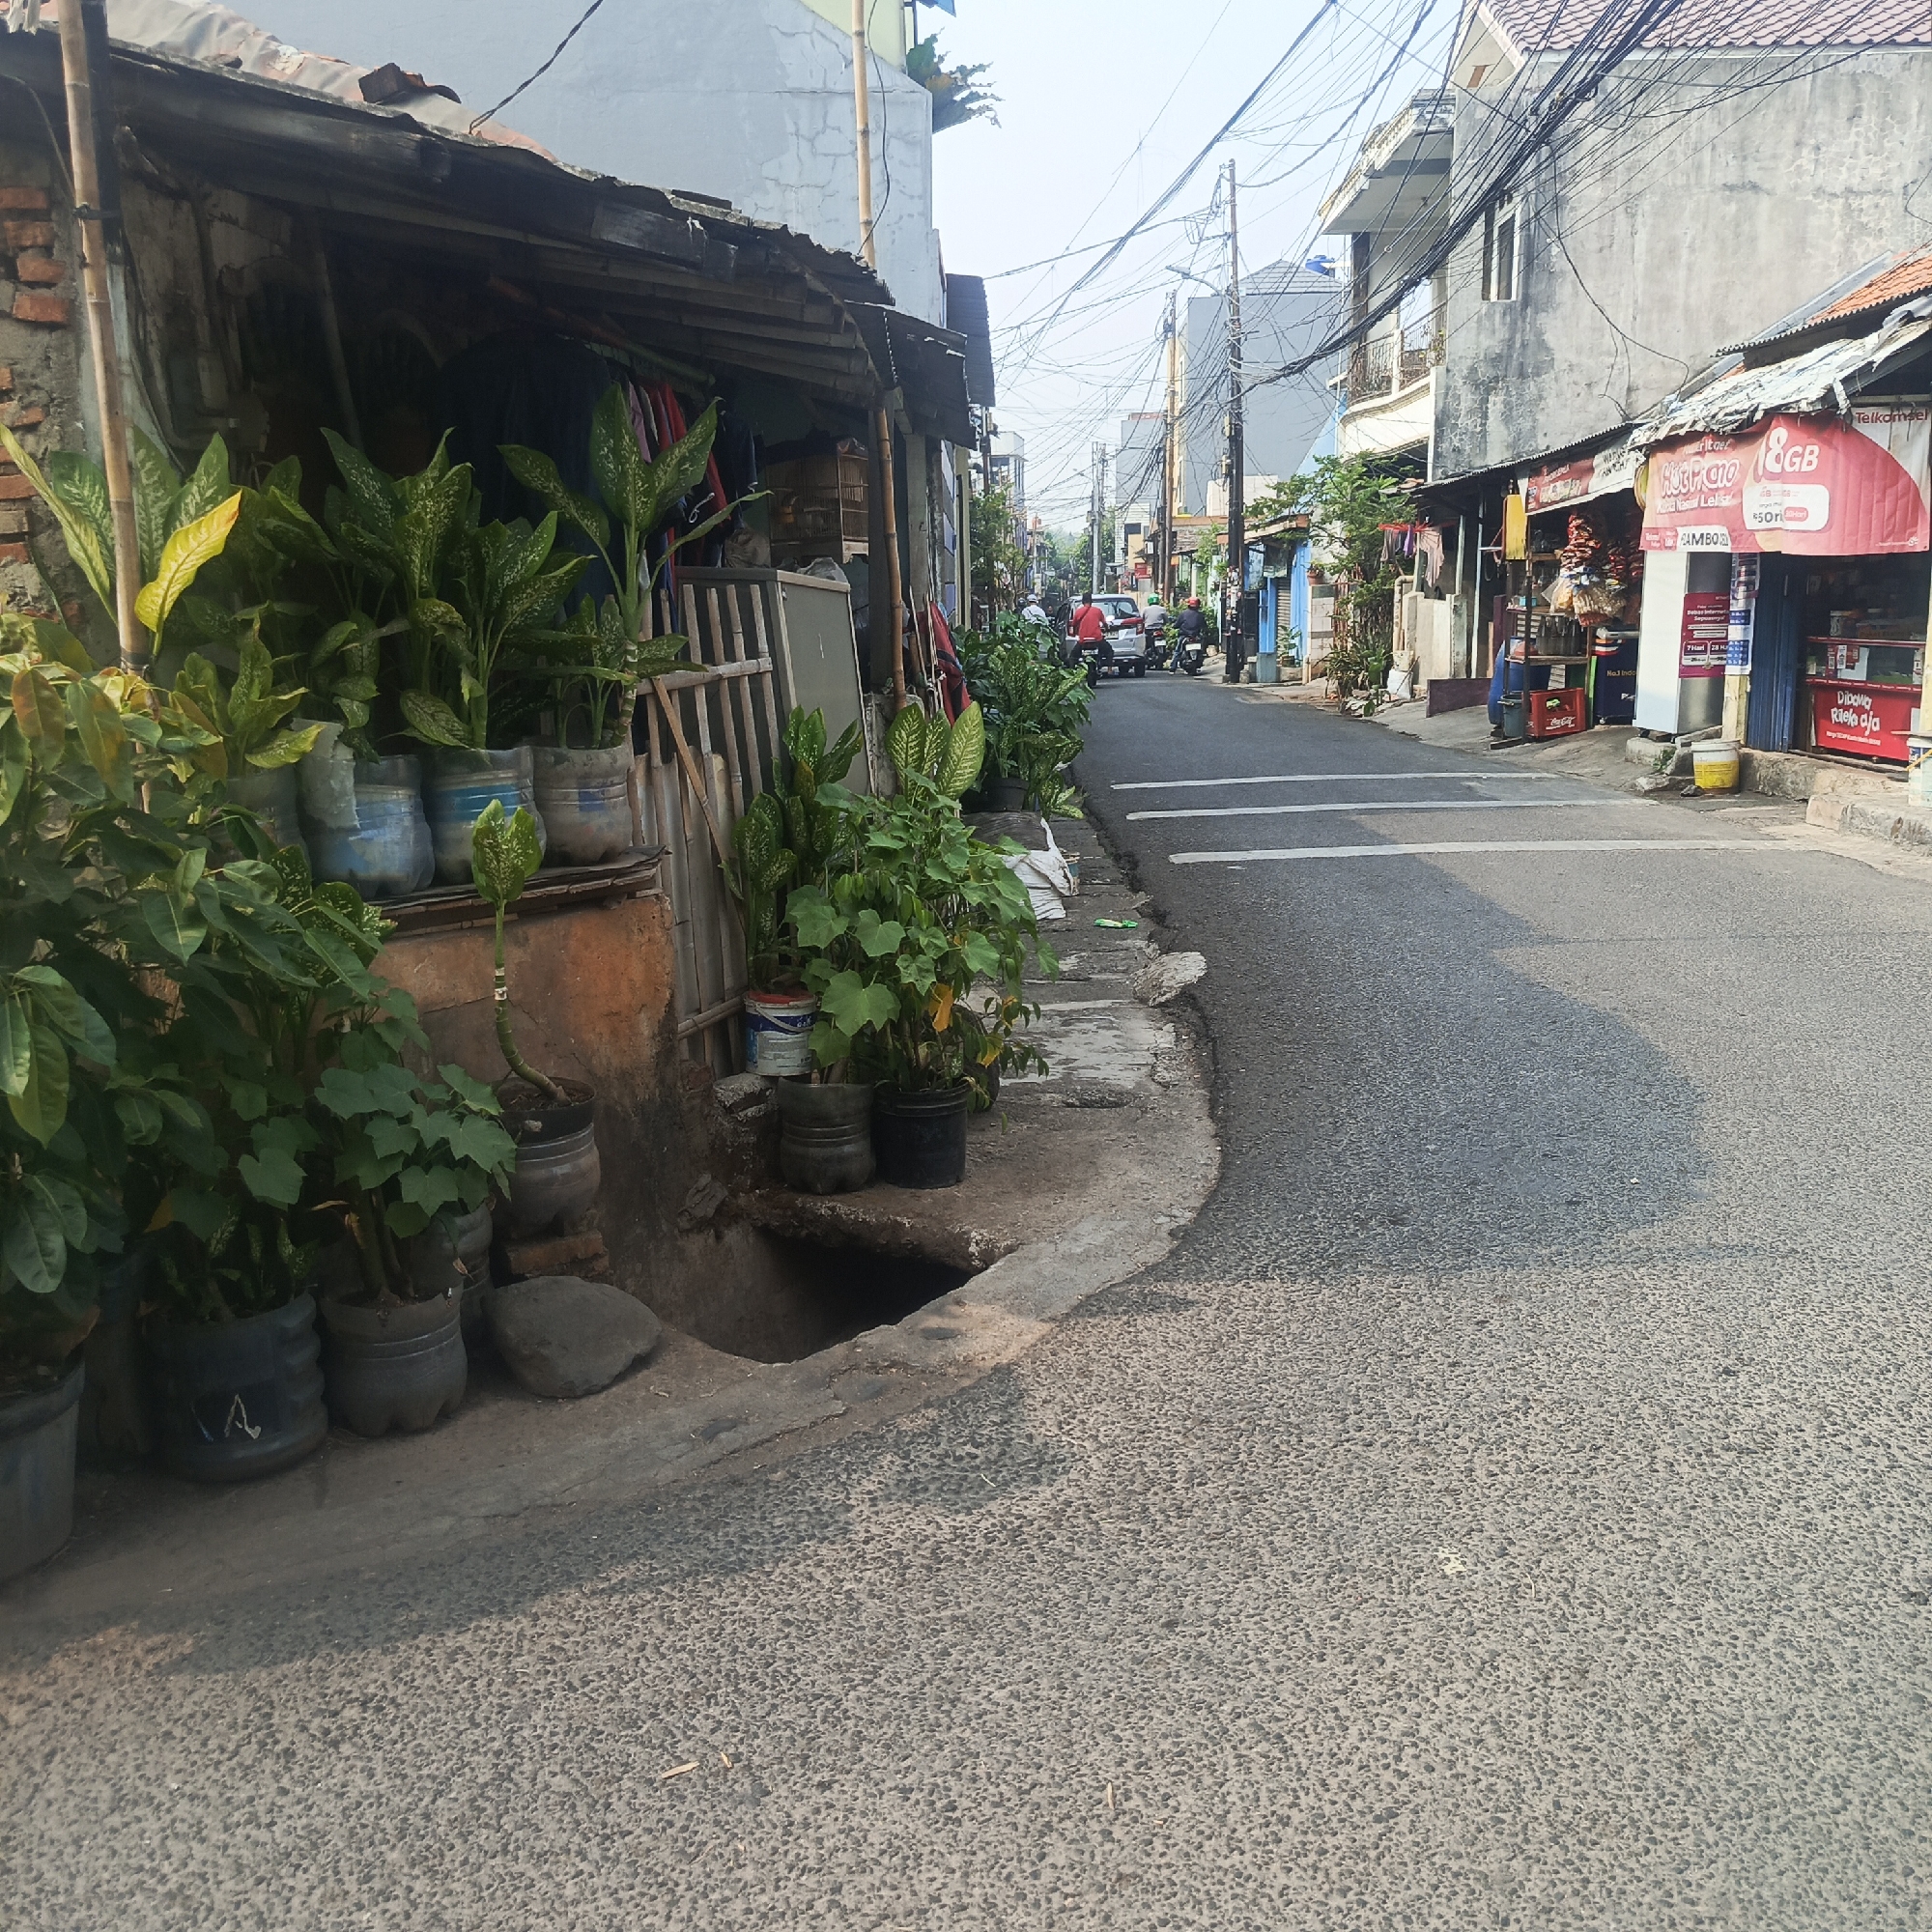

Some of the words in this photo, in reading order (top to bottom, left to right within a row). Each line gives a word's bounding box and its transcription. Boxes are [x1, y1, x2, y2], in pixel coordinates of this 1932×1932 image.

[1856, 410, 1928, 424] Telkomsel
[1837, 691, 1872, 710] Dibawa
[1860, 711, 1881, 736] aja
